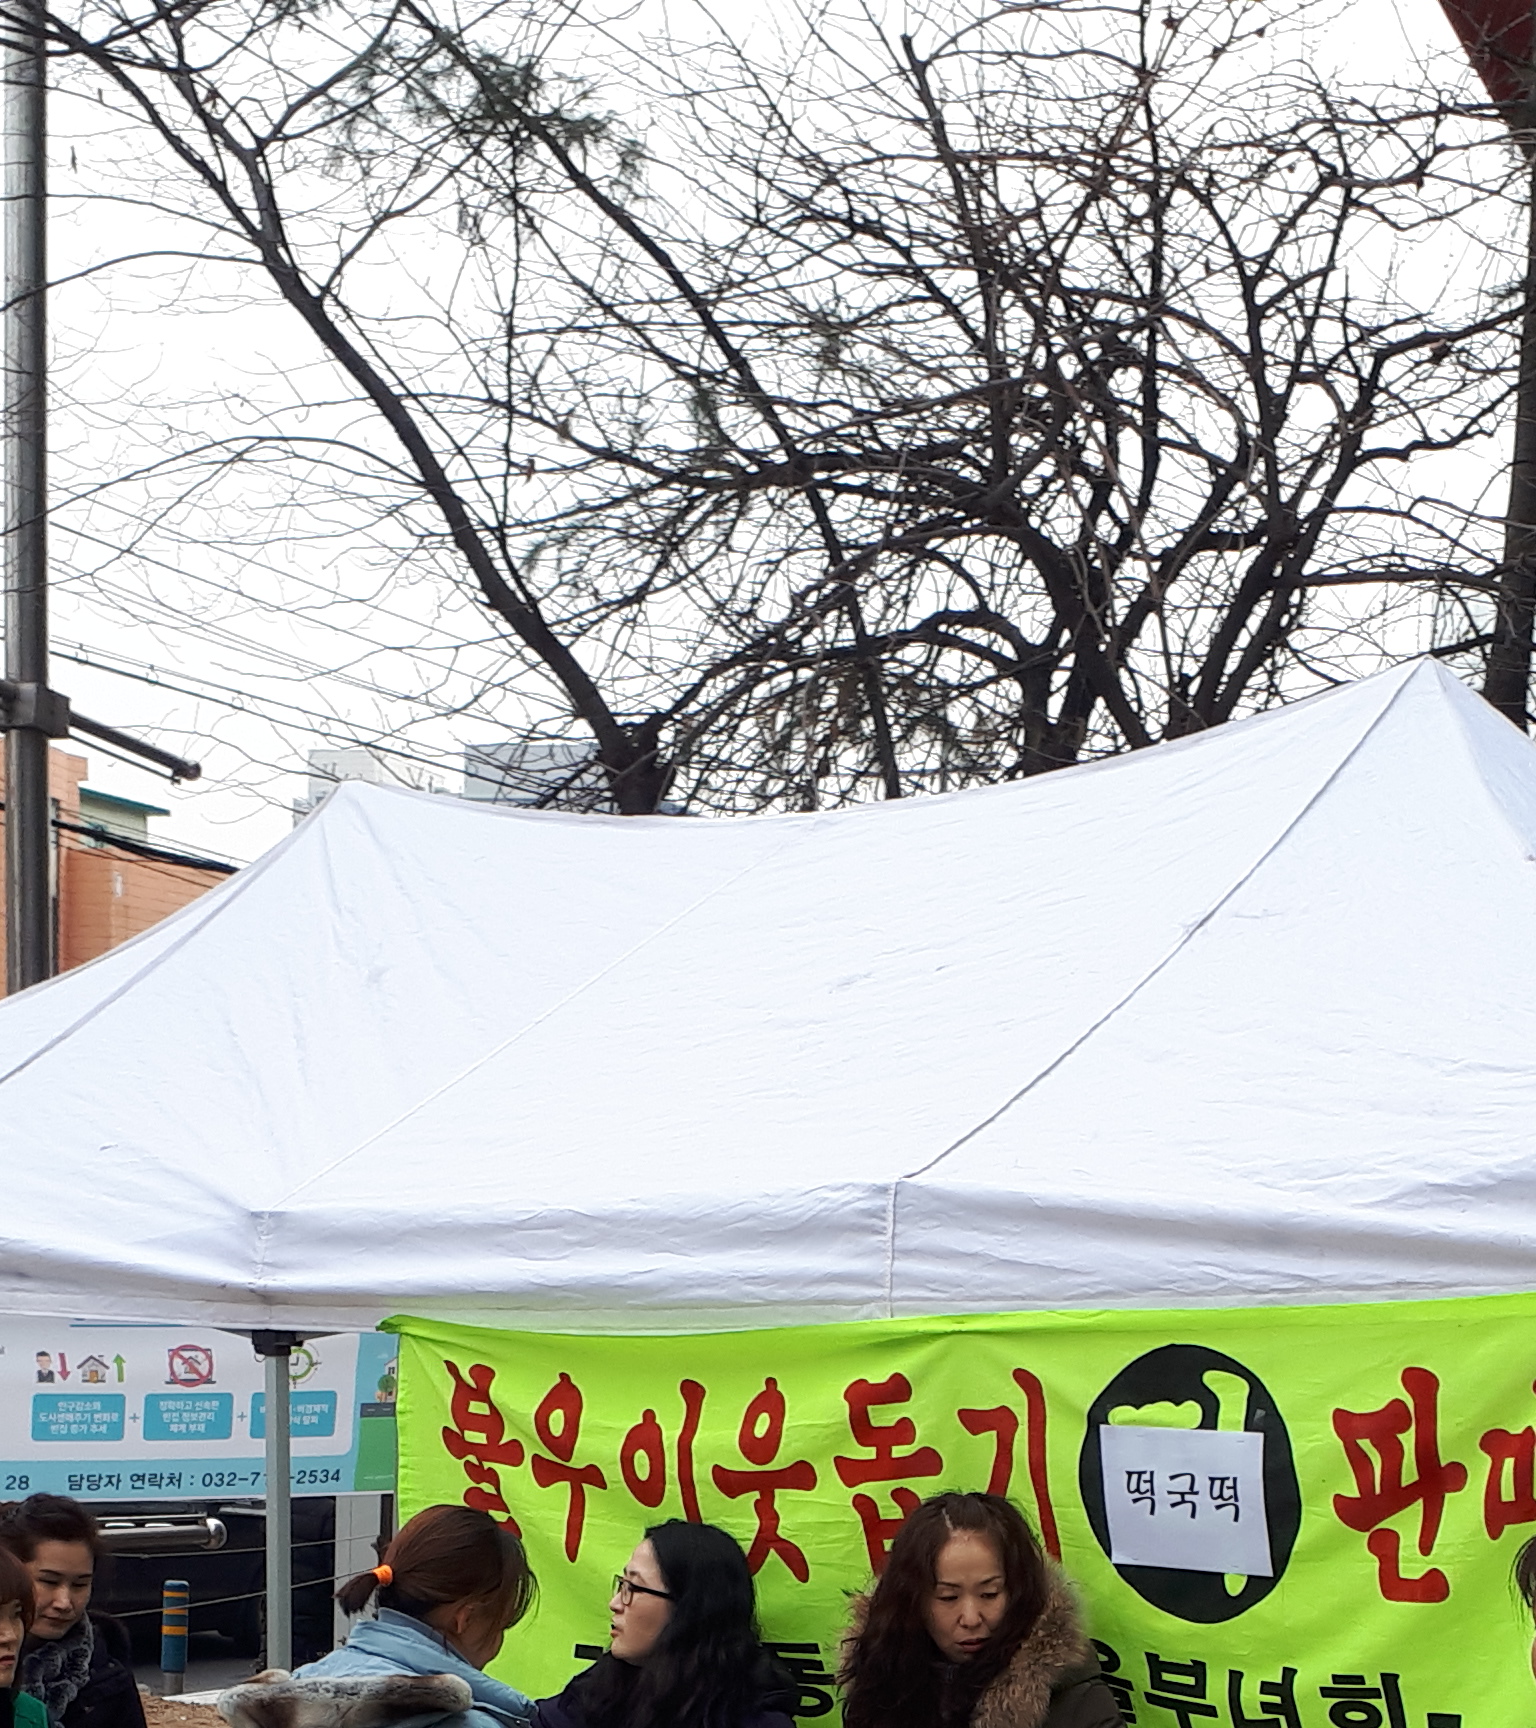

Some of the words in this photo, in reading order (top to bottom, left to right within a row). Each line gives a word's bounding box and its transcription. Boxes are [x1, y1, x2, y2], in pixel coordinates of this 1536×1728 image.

[5, 1475, 30, 1491] 28
[67, 1474, 123, 1491] 담당자
[129, 1472, 182, 1490] 연락처
[1125, 1469, 1240, 1523] 떡국떡
